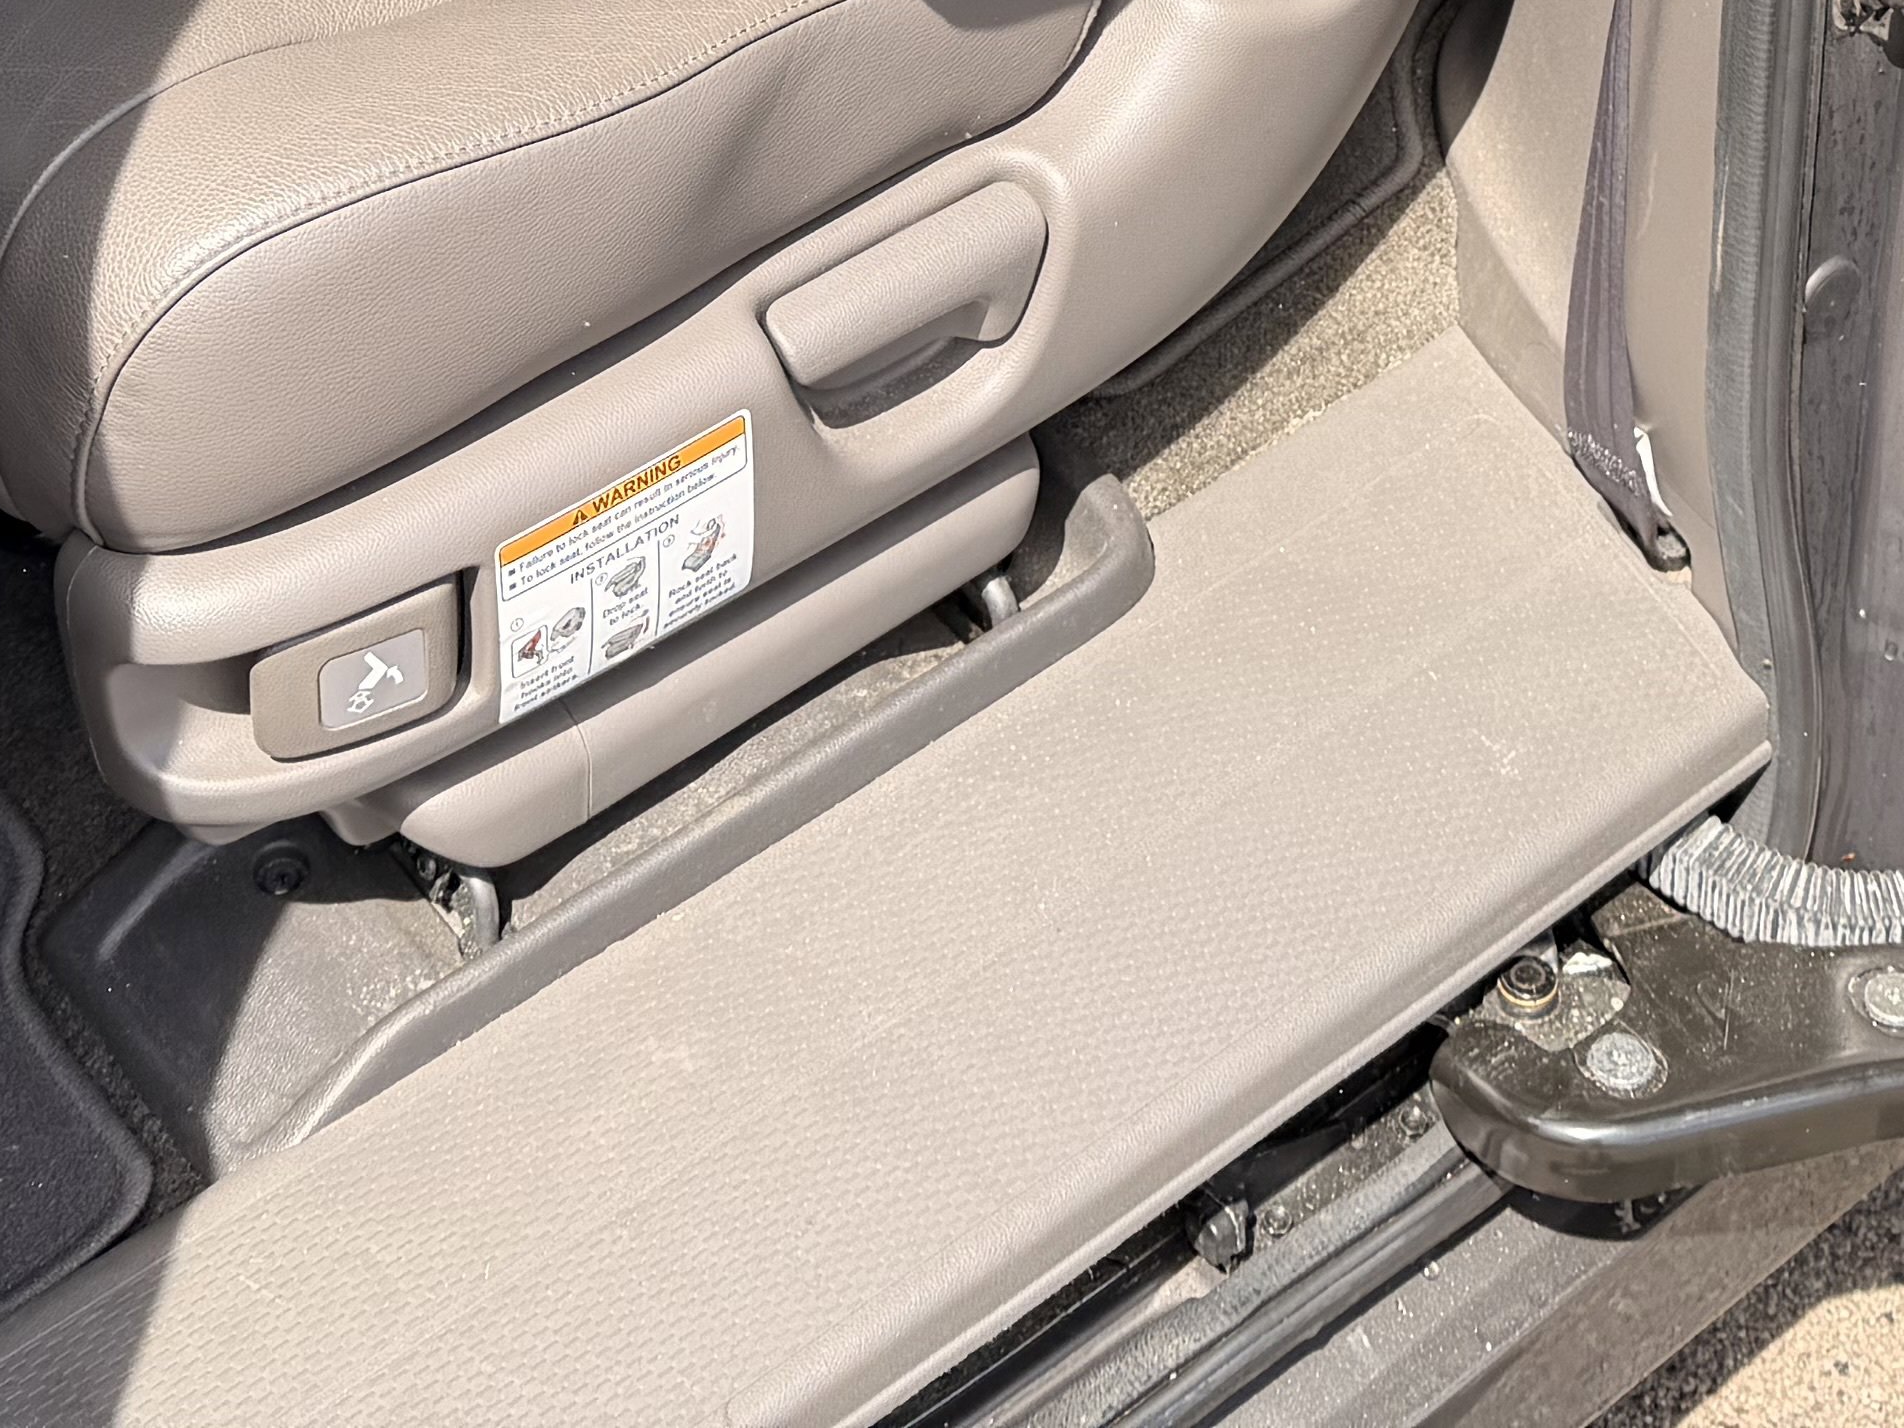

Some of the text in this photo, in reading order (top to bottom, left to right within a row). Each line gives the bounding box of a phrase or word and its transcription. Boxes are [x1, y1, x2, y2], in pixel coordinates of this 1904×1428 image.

[519, 549, 553, 572] Failure
[555, 542, 565, 552] to
[568, 529, 589, 545] lock
[591, 515, 611, 533] seat
[614, 505, 631, 520] can
[633, 487, 660, 509] result
[663, 482, 672, 492] in
[675, 462, 708, 486] serious
[592, 454, 682, 513] WARNING
[520, 574, 533, 585] To
[535, 561, 555, 577] lock
[584, 531, 613, 551] follow
[616, 520, 631, 533] the
[634, 490, 685, 523] instruction
[570, 513, 679, 584] INSTALLATION
